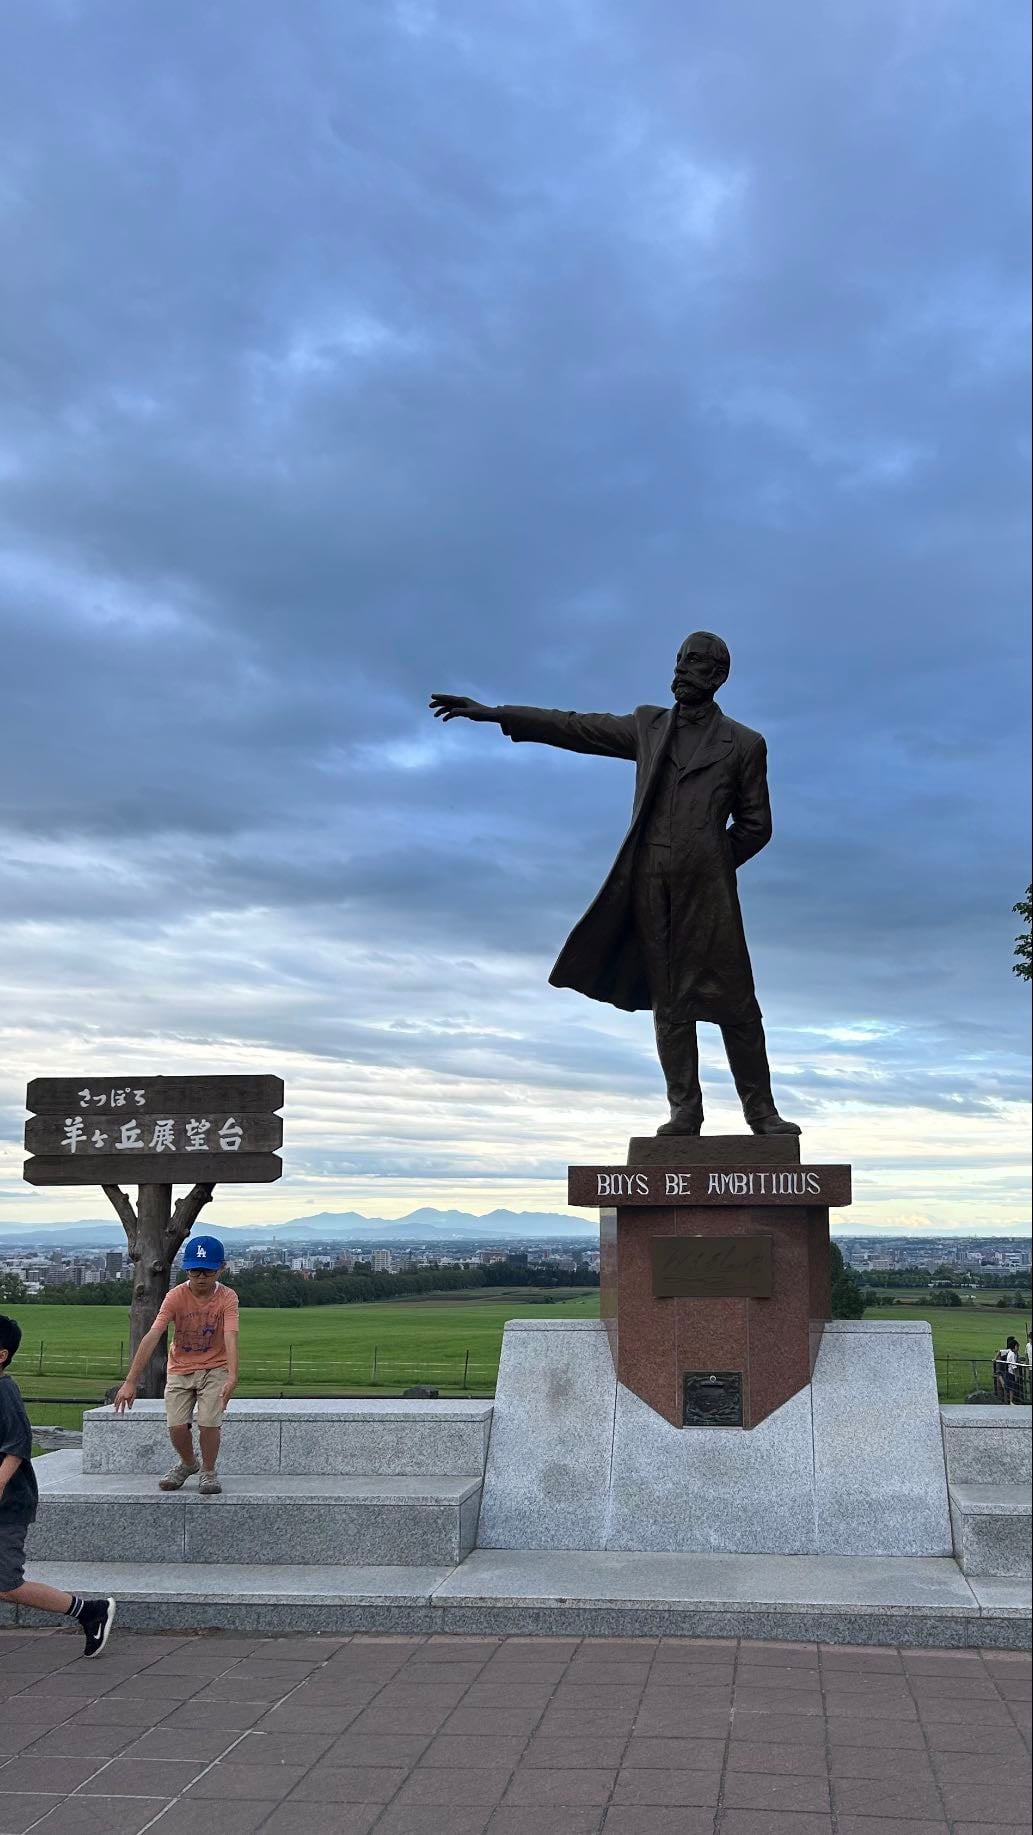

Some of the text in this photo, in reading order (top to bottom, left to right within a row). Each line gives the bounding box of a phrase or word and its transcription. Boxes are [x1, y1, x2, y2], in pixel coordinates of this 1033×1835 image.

[597, 1172, 821, 1196] BOYS BE AMBITIOUS
[196, 1245, 206, 1258] LA
